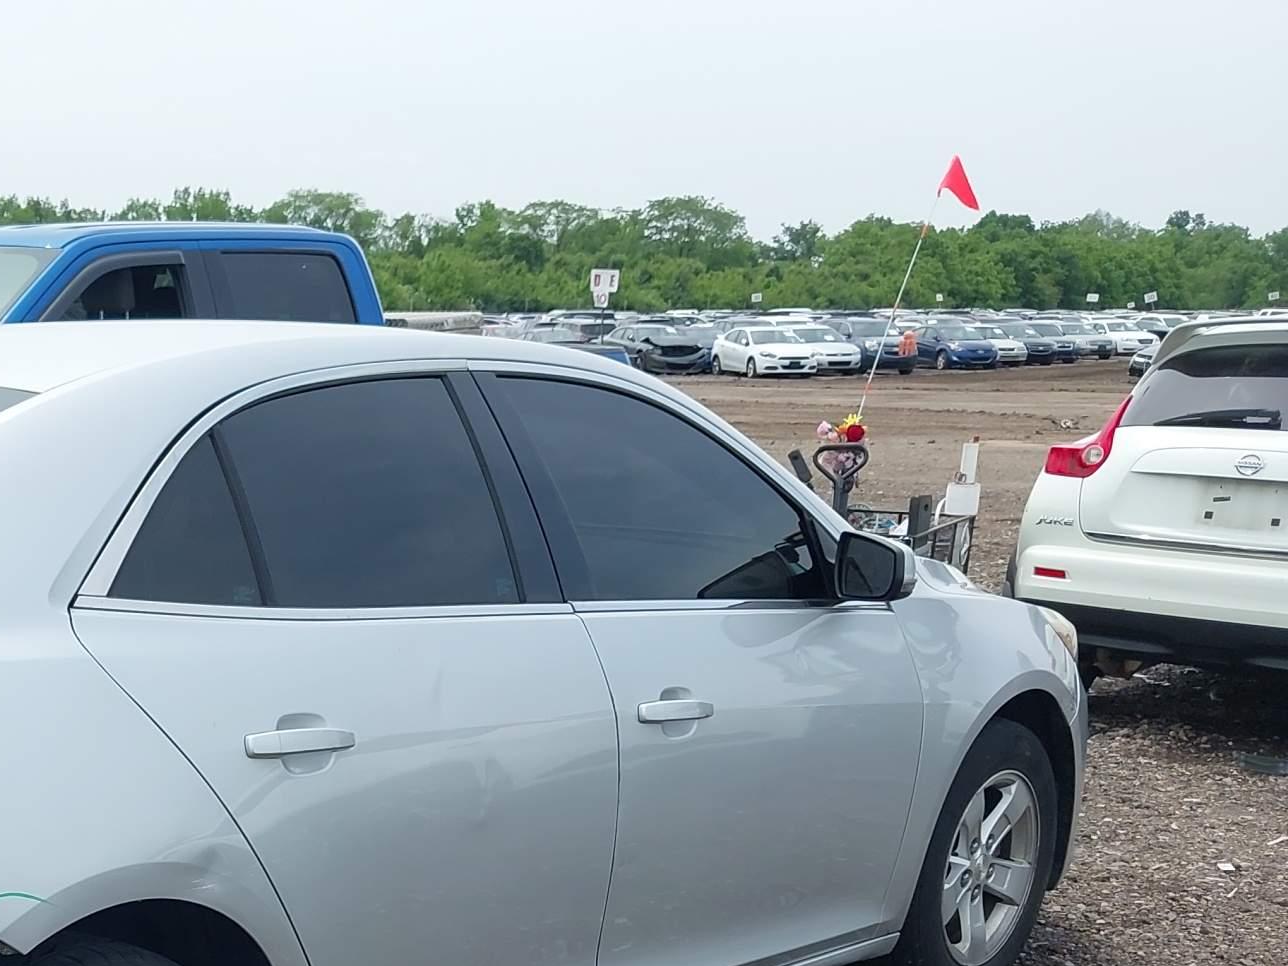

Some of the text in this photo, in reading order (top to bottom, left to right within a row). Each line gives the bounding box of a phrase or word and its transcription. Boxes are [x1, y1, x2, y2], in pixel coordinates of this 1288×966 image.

[594, 274, 601, 287] D
[596, 293, 607, 305] 10
[1035, 517, 1074, 527] JUKE
